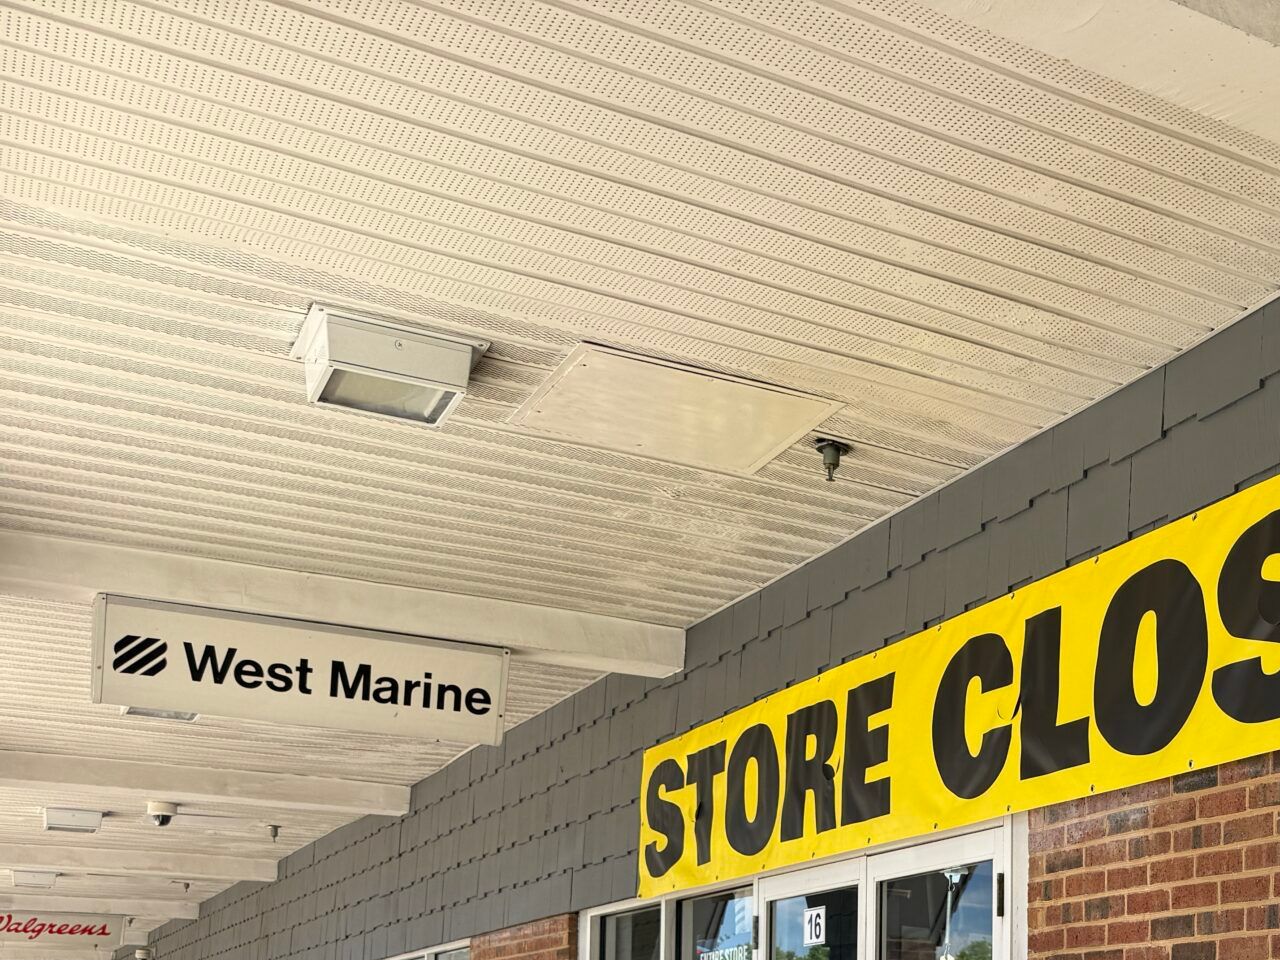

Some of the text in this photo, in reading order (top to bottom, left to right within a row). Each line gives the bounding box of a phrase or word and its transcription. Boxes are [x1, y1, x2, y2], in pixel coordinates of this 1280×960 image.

[183, 641, 492, 716] West Marine
[645, 672, 896, 878] STORE
[808, 912, 822, 941] 16
